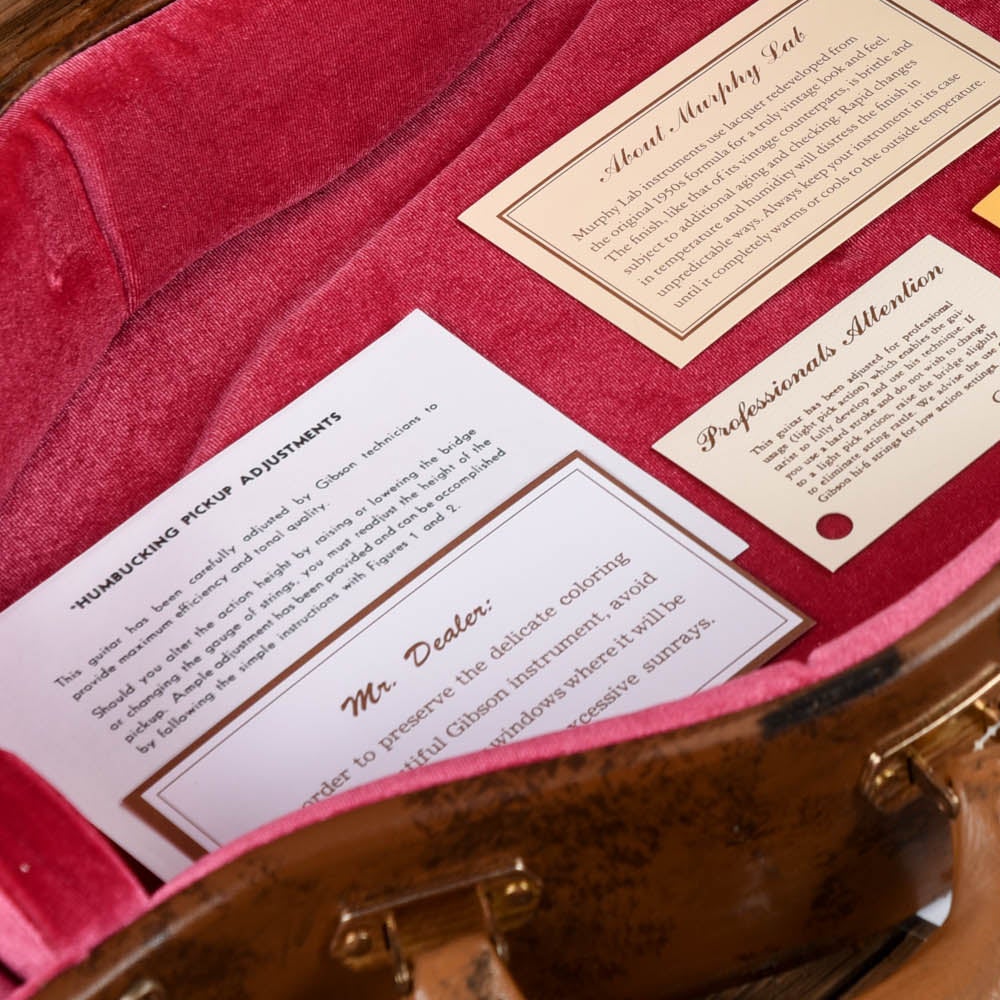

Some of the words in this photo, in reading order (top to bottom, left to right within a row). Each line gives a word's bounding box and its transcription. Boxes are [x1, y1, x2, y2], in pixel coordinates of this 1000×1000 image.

[571, 205, 621, 243] Murphy
[616, 189, 643, 208] Lab
[641, 143, 708, 191] instruments
[705, 128, 728, 145] use
[722, 99, 767, 131] lacquer
[765, 52, 832, 103] redeveloped
[827, 36, 859, 56] from
[599, 124, 664, 183] About
[668, 64, 761, 133] Murphy
[760, 25, 806, 62] Lab
[623, 241, 667, 276] subject
[663, 231, 679, 244] to
[678, 187, 737, 233] additional
[734, 166, 771, 192] aging
[766, 148, 791, 169] and
[788, 115, 842, 153] checking.
[836, 87, 875, 115] Rapid
[873, 59, 919, 91] changes
[637, 274, 656, 287] in
[652, 221, 724, 276] temperature
[722, 203, 747, 224] and
[741, 168, 797, 208] humidity
[793, 151, 819, 170] will
[815, 123, 860, 155] distress
[856, 109, 878, 126] the
[874, 88, 909, 112] finish
[906, 79, 922, 90] in
[696, 342, 837, 453] Professionals
[841, 265, 944, 346] Attention
[749, 438, 774, 456] This
[775, 415, 804, 440] guitar
[802, 401, 823, 416] has
[820, 384, 846, 402] been
[846, 353, 885, 384] adjusted
[883, 341, 901, 355] for
[901, 299, 954, 343] professional
[762, 443, 789, 464] usage
[788, 420, 818, 444] (light
[816, 405, 838, 424] pick
[837, 380, 870, 407] action)
[869, 359, 899, 381] which
[897, 334, 931, 360] enables
[930, 322, 947, 336] the
[945, 309, 964, 325] gui-
[817, 477, 853, 504] Gibson
[871, 437, 903, 463] strings
[899, 425, 917, 439] for
[914, 411, 935, 427] low
[934, 390, 964, 413] action
[962, 363, 1000, 391] settings.
[53, 669, 83, 688] This
[87, 637, 123, 668] guitar
[123, 616, 150, 635] has
[149, 589, 184, 613] been
[188, 544, 237, 585] carefully
[242, 504, 291, 543] adjusted
[291, 492, 312, 506] by
[314, 461, 358, 490] Gibson
[360, 415, 422, 459] technicians
[423, 403, 439, 414] to
[179, 485, 233, 526] PICKUP
[239, 411, 342, 487] ADJUSTMENTS
[340, 680, 397, 718] Mr.
[403, 598, 493, 669] Dealer:
[352, 750, 377, 769] to
[377, 686, 456, 753] preserve
[455, 660, 489, 686] the
[489, 606, 558, 661] delicate
[559, 551, 632, 607] coloring
[445, 688, 511, 739] Gibson
[505, 612, 612, 690] instrument,
[608, 570, 659, 611] avoid
[562, 646, 619, 689] where
[612, 633, 635, 650] it
[629, 607, 667, 636] will
[657, 594, 687, 613] be
[641, 617, 716, 674] sunrays.
